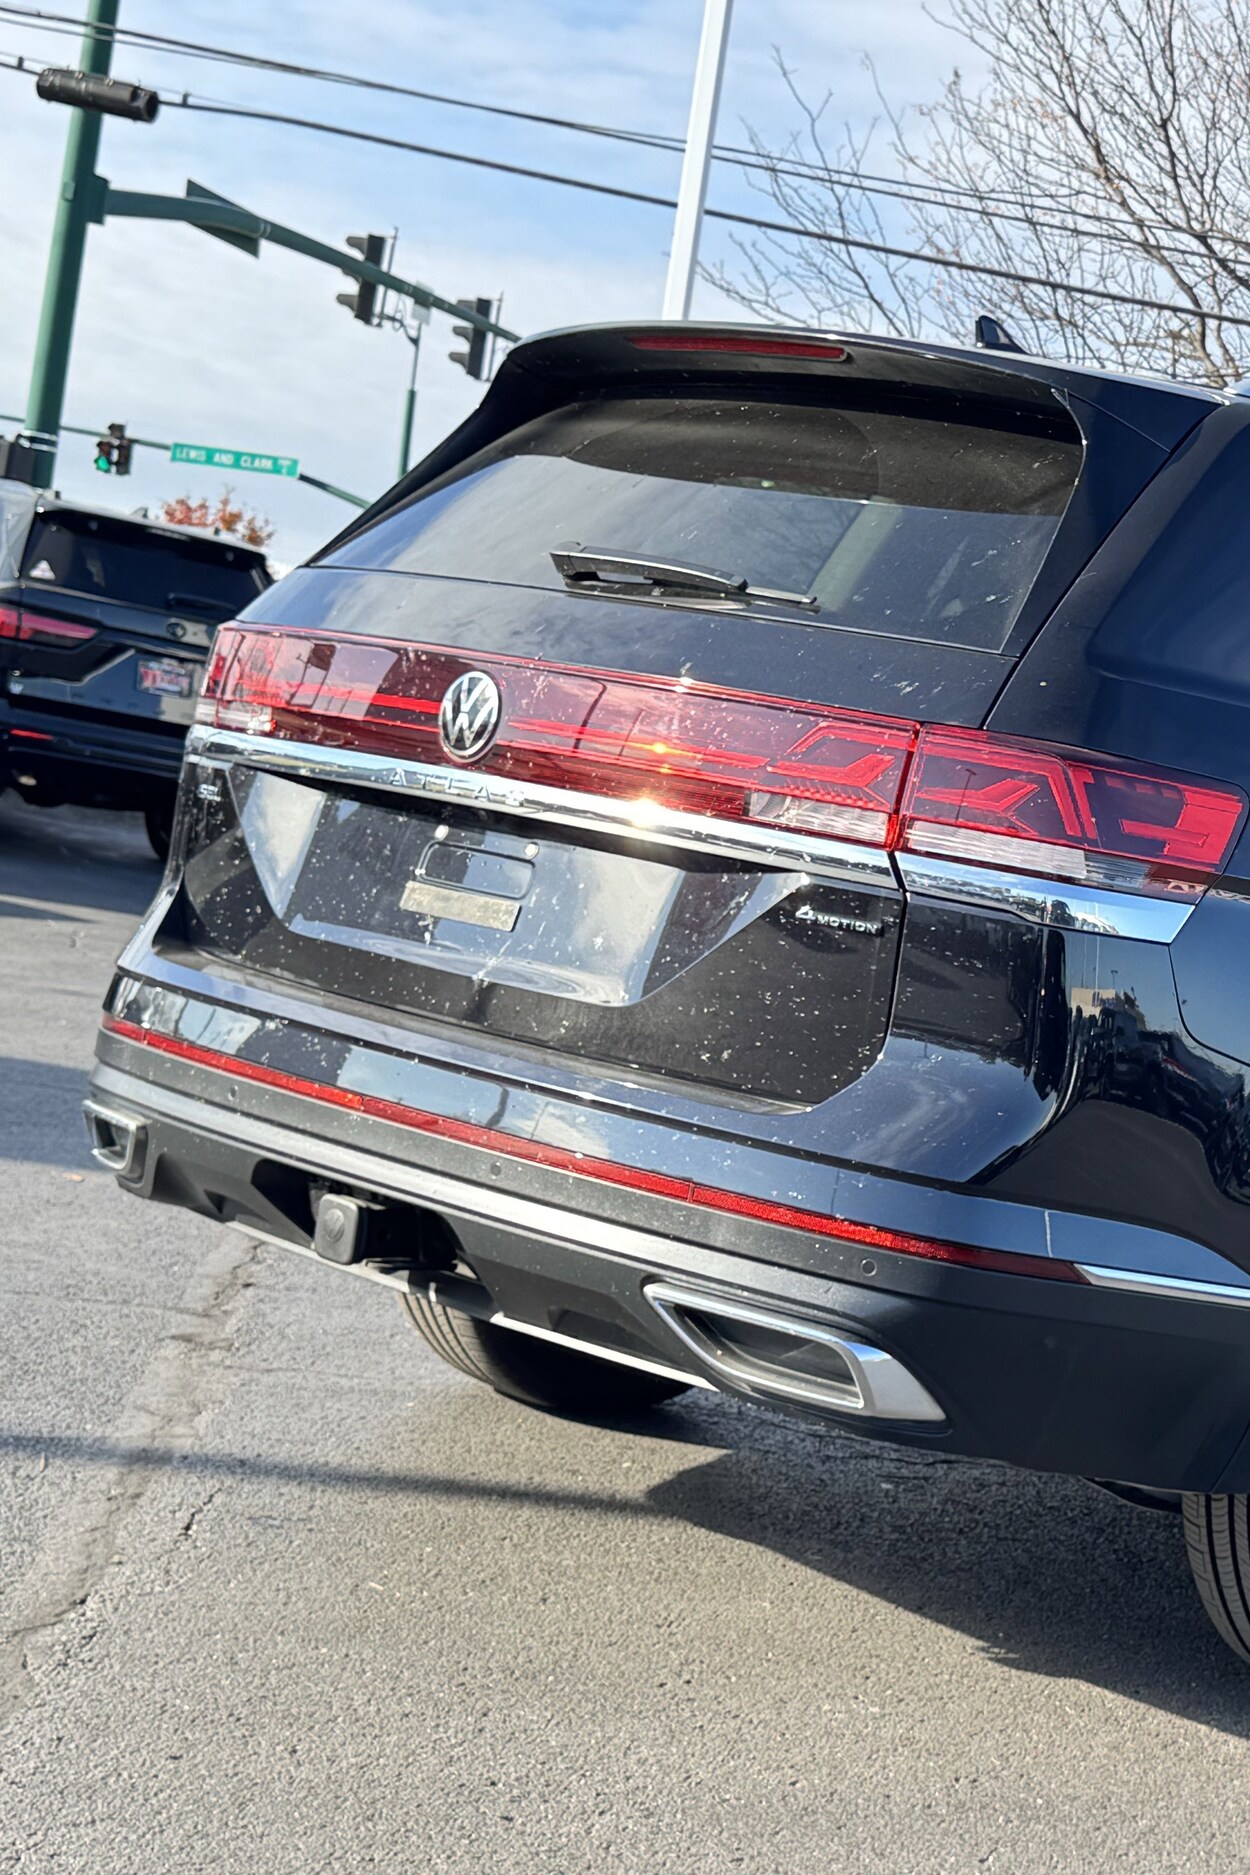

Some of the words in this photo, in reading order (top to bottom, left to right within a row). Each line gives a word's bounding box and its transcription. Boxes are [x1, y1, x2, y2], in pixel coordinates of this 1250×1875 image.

[176, 448, 206, 462] LEWIS
[213, 453, 234, 466] AND
[240, 456, 273, 471] CLARK
[390, 768, 525, 807] ATLAS
